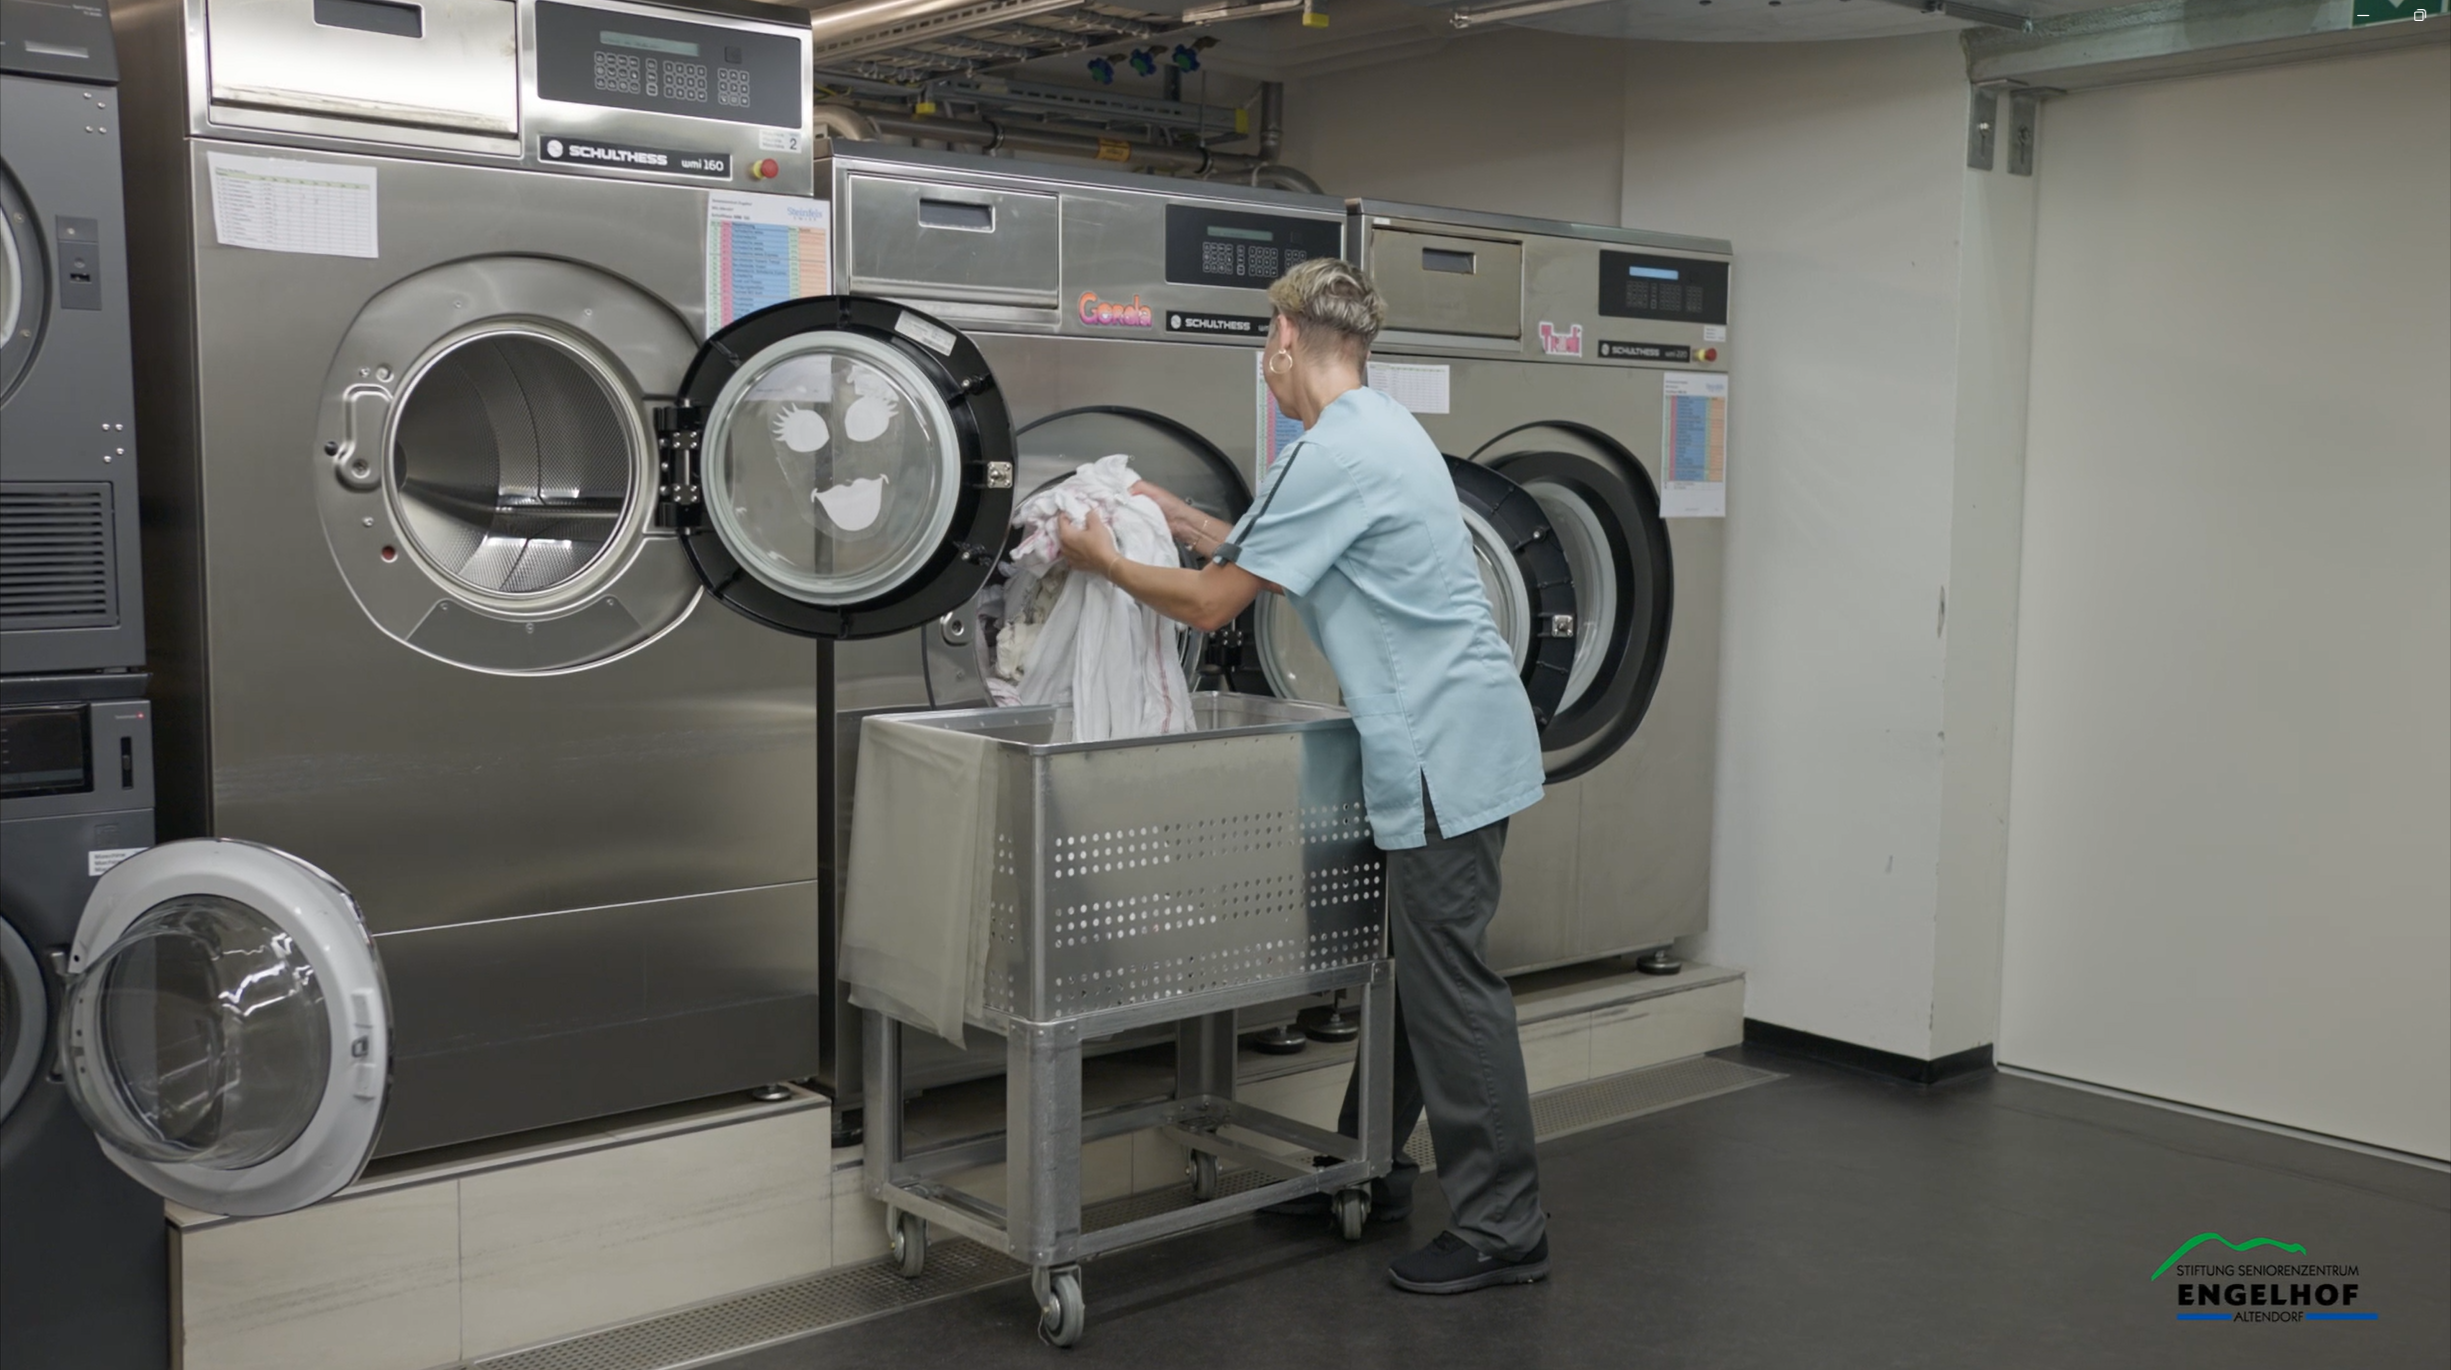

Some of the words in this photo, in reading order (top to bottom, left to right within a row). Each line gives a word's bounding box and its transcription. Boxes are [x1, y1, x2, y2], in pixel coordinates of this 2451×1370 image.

[789, 137, 798, 150] 2
[568, 144, 668, 167] SCHULTHESS
[681, 158, 702, 171] wmi
[704, 158, 724, 172] 160
[1185, 317, 1251, 331] SCHULTHESS
[1611, 345, 1660, 357] SCHULTHESS
